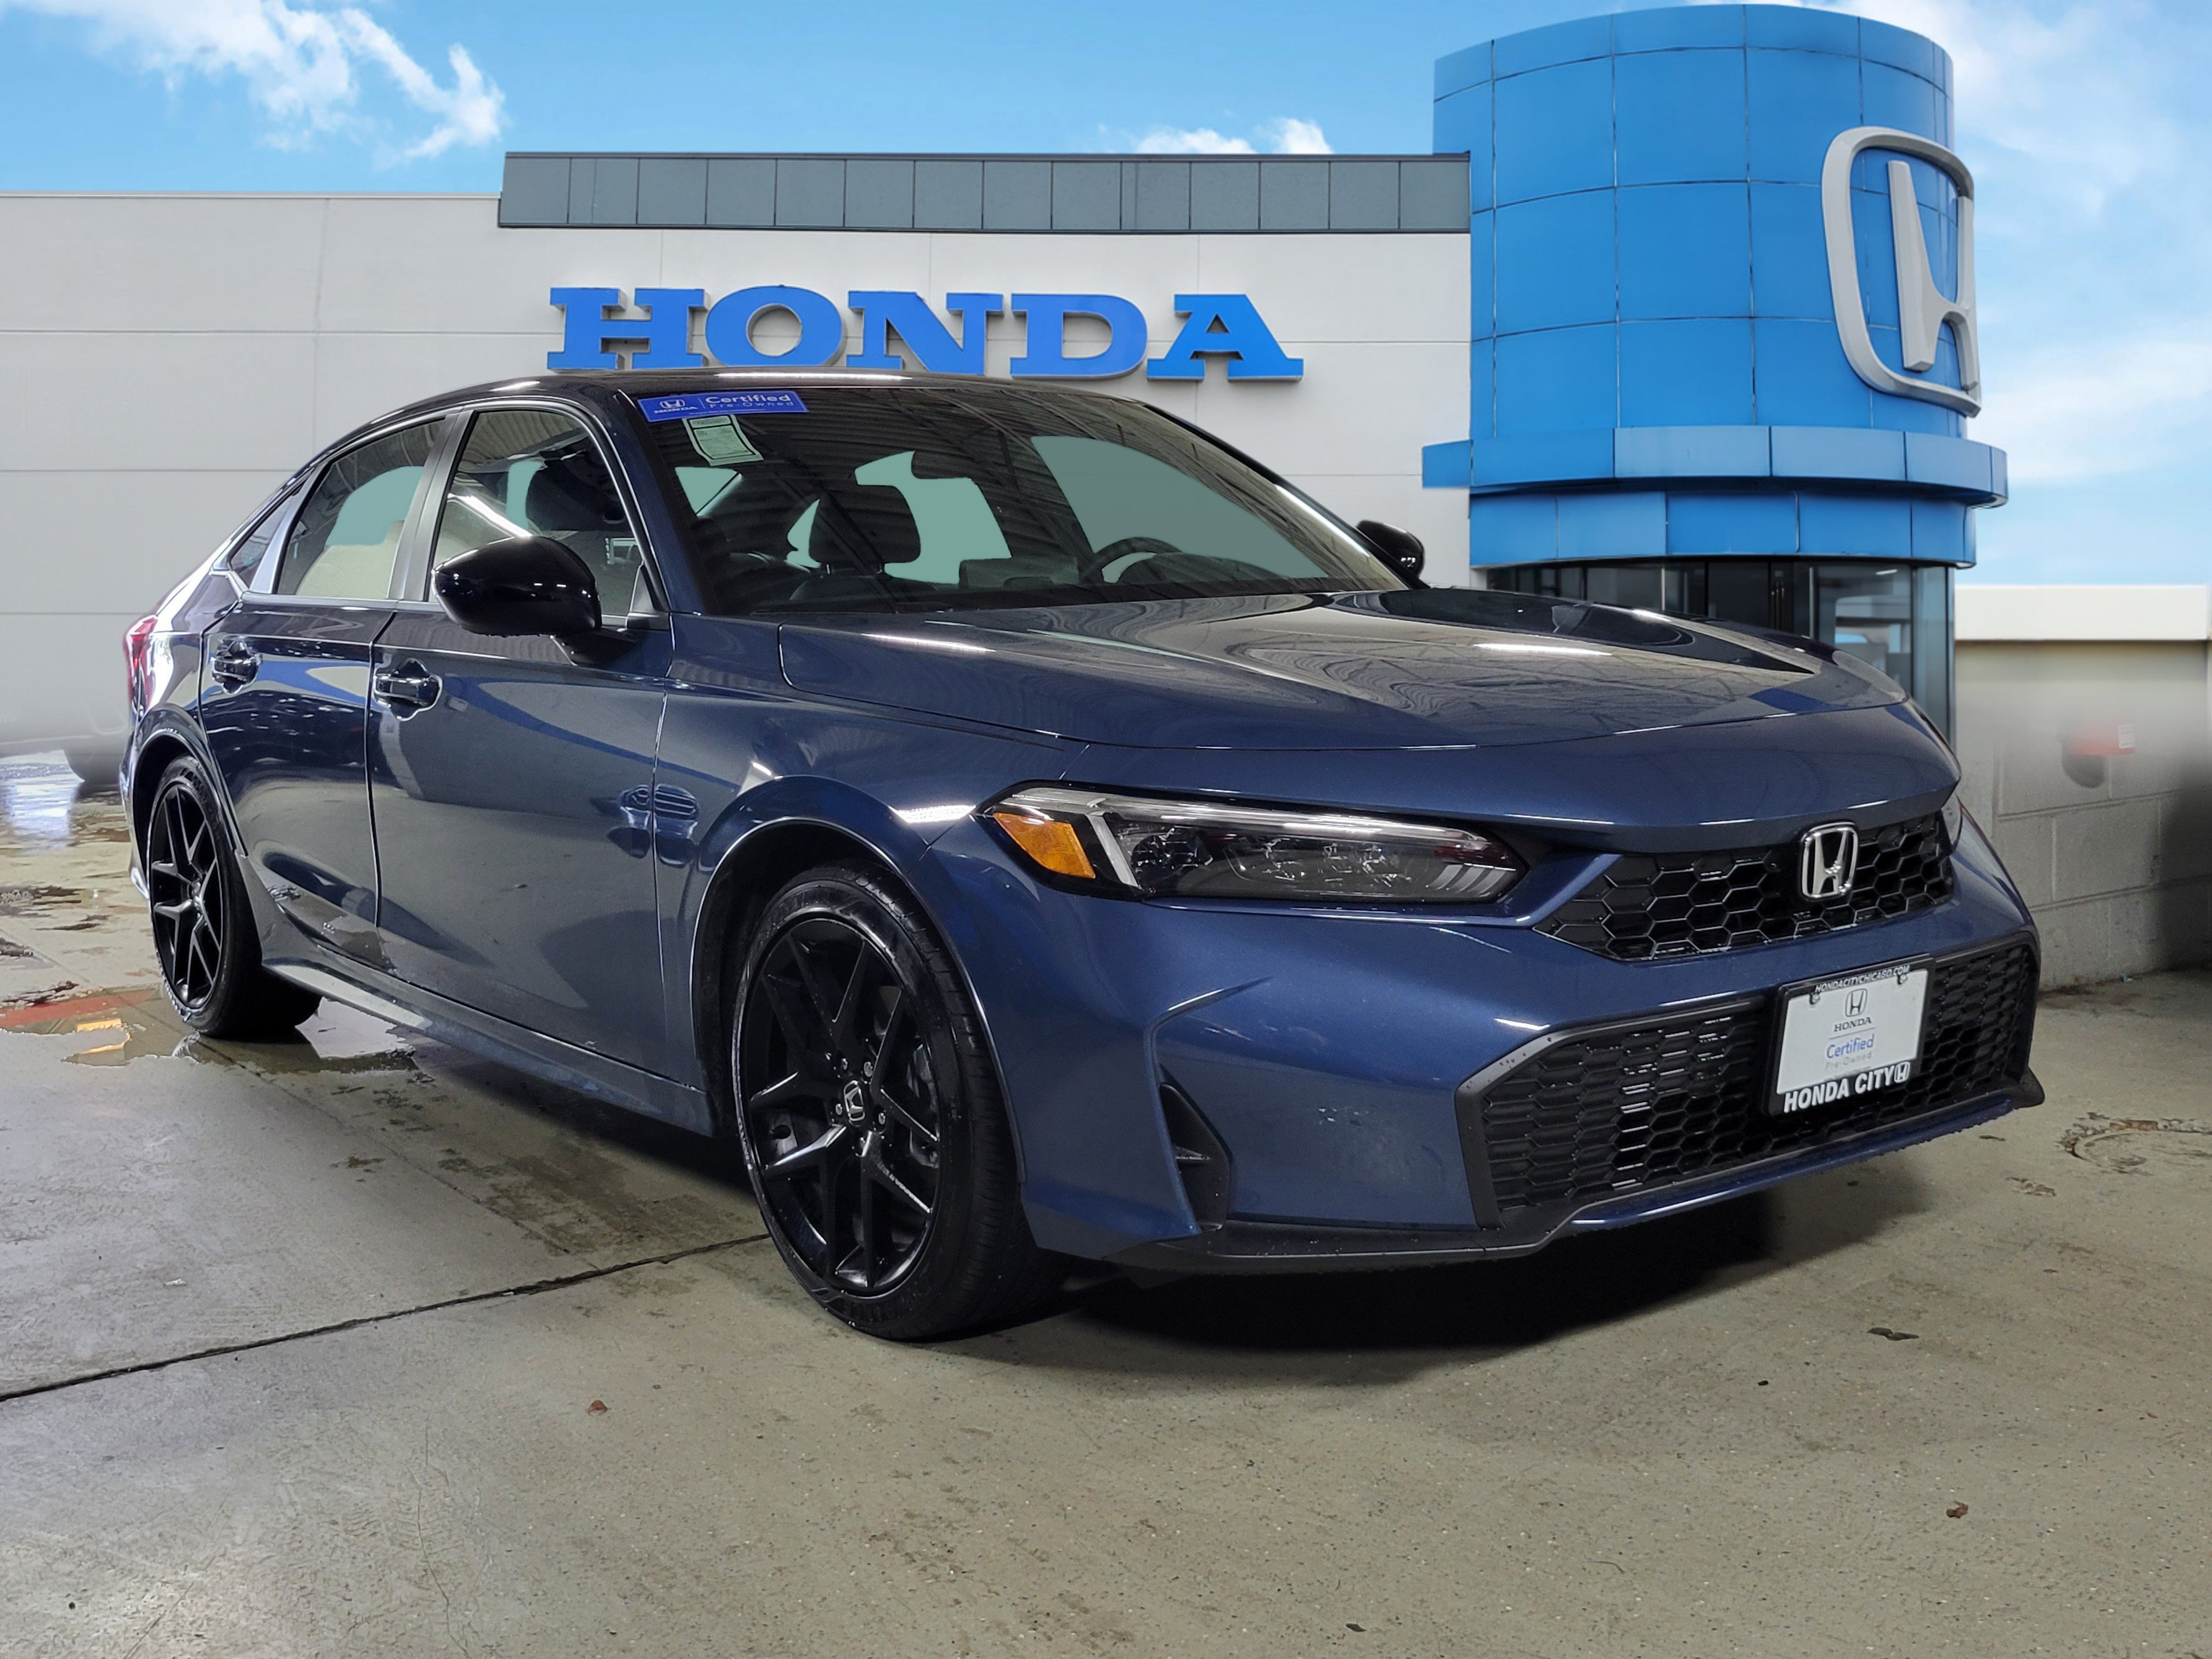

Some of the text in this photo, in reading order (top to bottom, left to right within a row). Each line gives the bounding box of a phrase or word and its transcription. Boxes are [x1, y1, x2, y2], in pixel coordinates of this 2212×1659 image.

[548, 285, 1304, 381] HONDA
[706, 394, 791, 404] Certified
[1815, 965, 1910, 993] HONDACITYCHICAGO.COM
[1834, 1017, 1871, 1032] HONDA
[1826, 1033, 1875, 1058] Certified
[1784, 1079, 1849, 1113] HONDA
[1855, 1065, 1895, 1094] CITY
